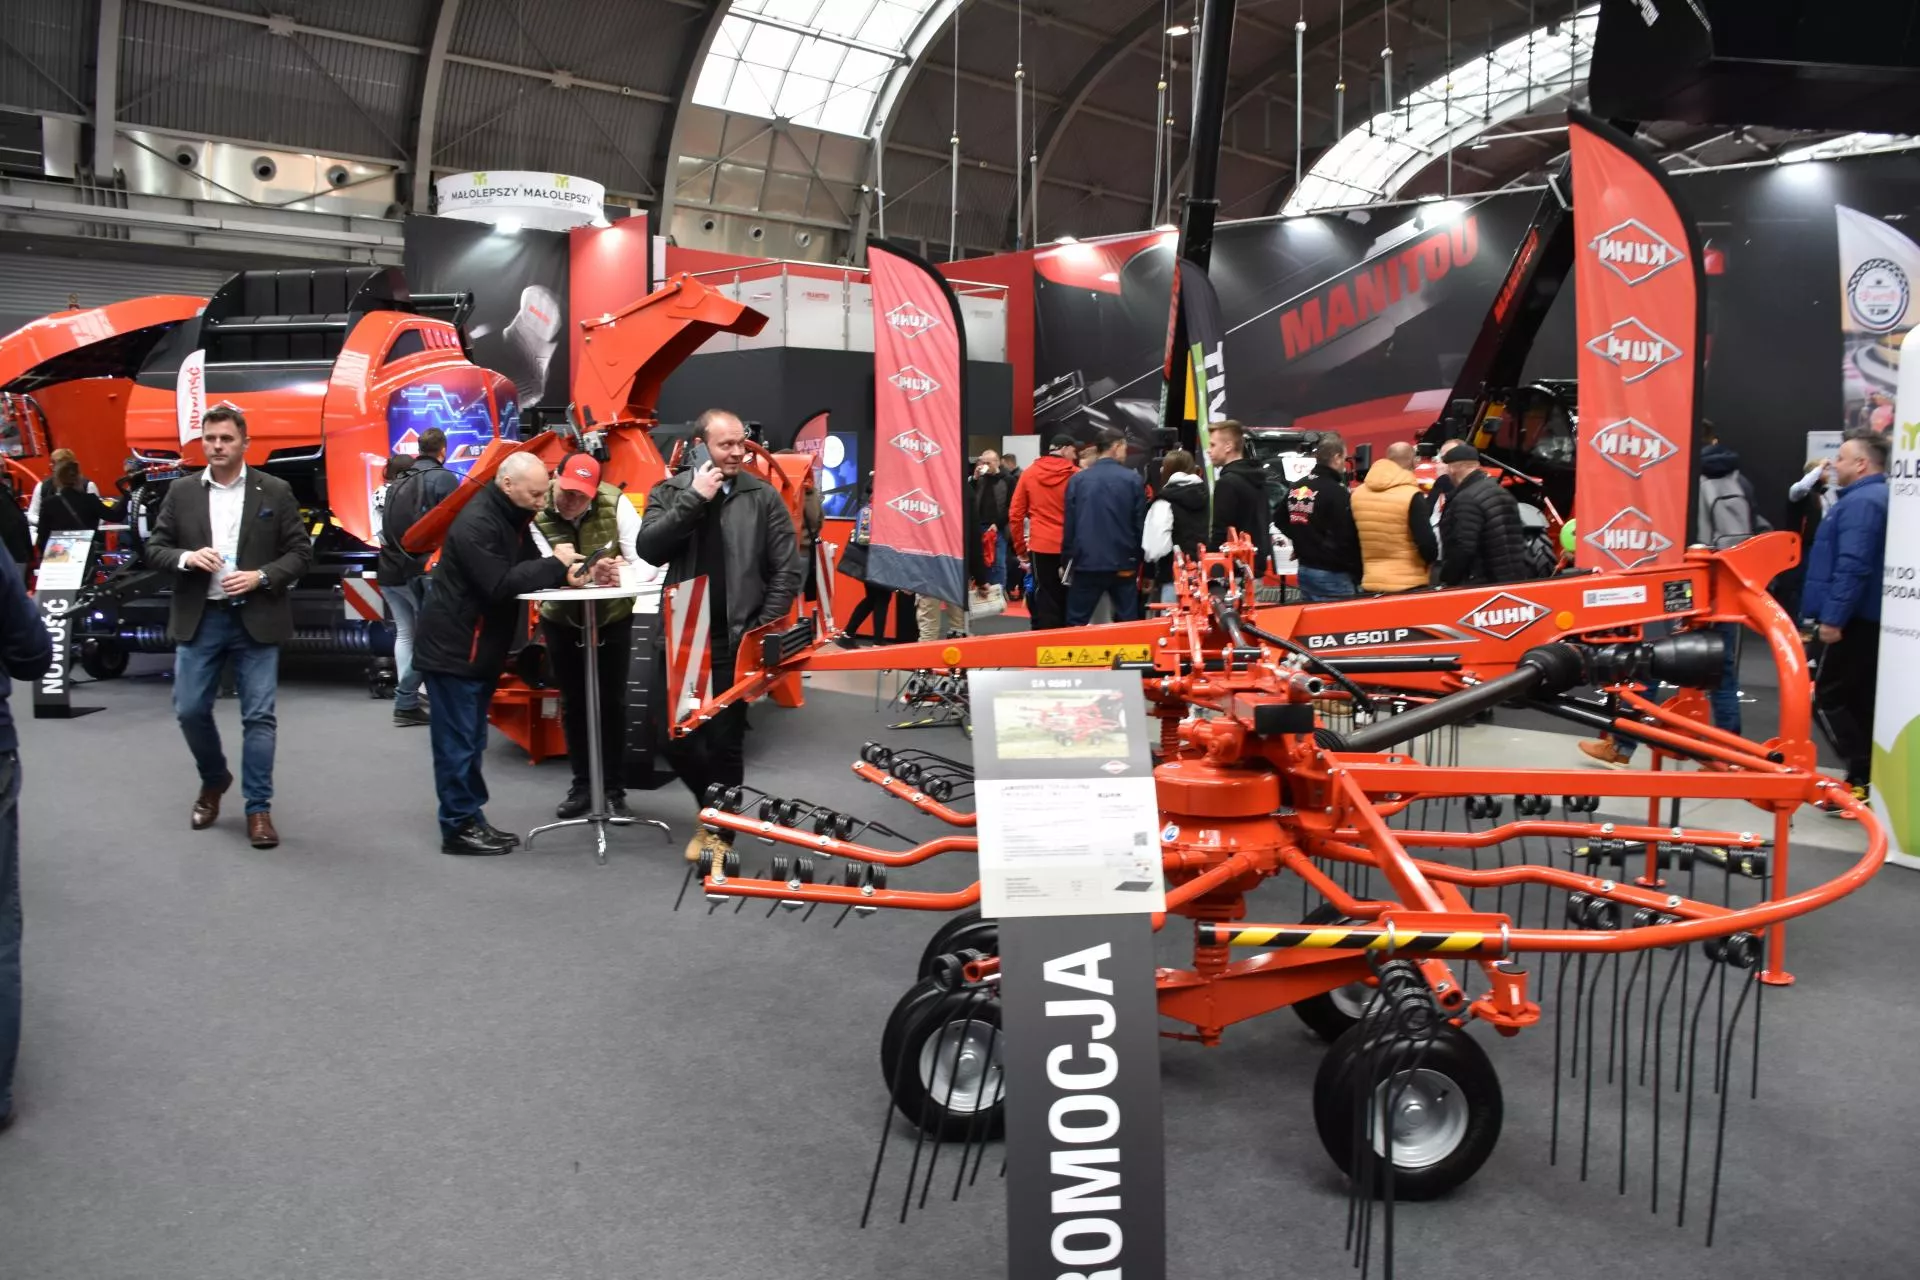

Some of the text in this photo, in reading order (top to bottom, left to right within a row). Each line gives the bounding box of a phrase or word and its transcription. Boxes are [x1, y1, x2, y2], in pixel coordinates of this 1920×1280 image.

[451, 187, 519, 200] MAŁOLEPSZY
[523, 188, 591, 205] MAŁOLEPSZY
[1280, 215, 1480, 361] MANITOU
[1472, 605, 1536, 628] KUHN
[1308, 628, 1409, 649] GA 6501 P
[1043, 942, 1123, 1280] OMOCJA
